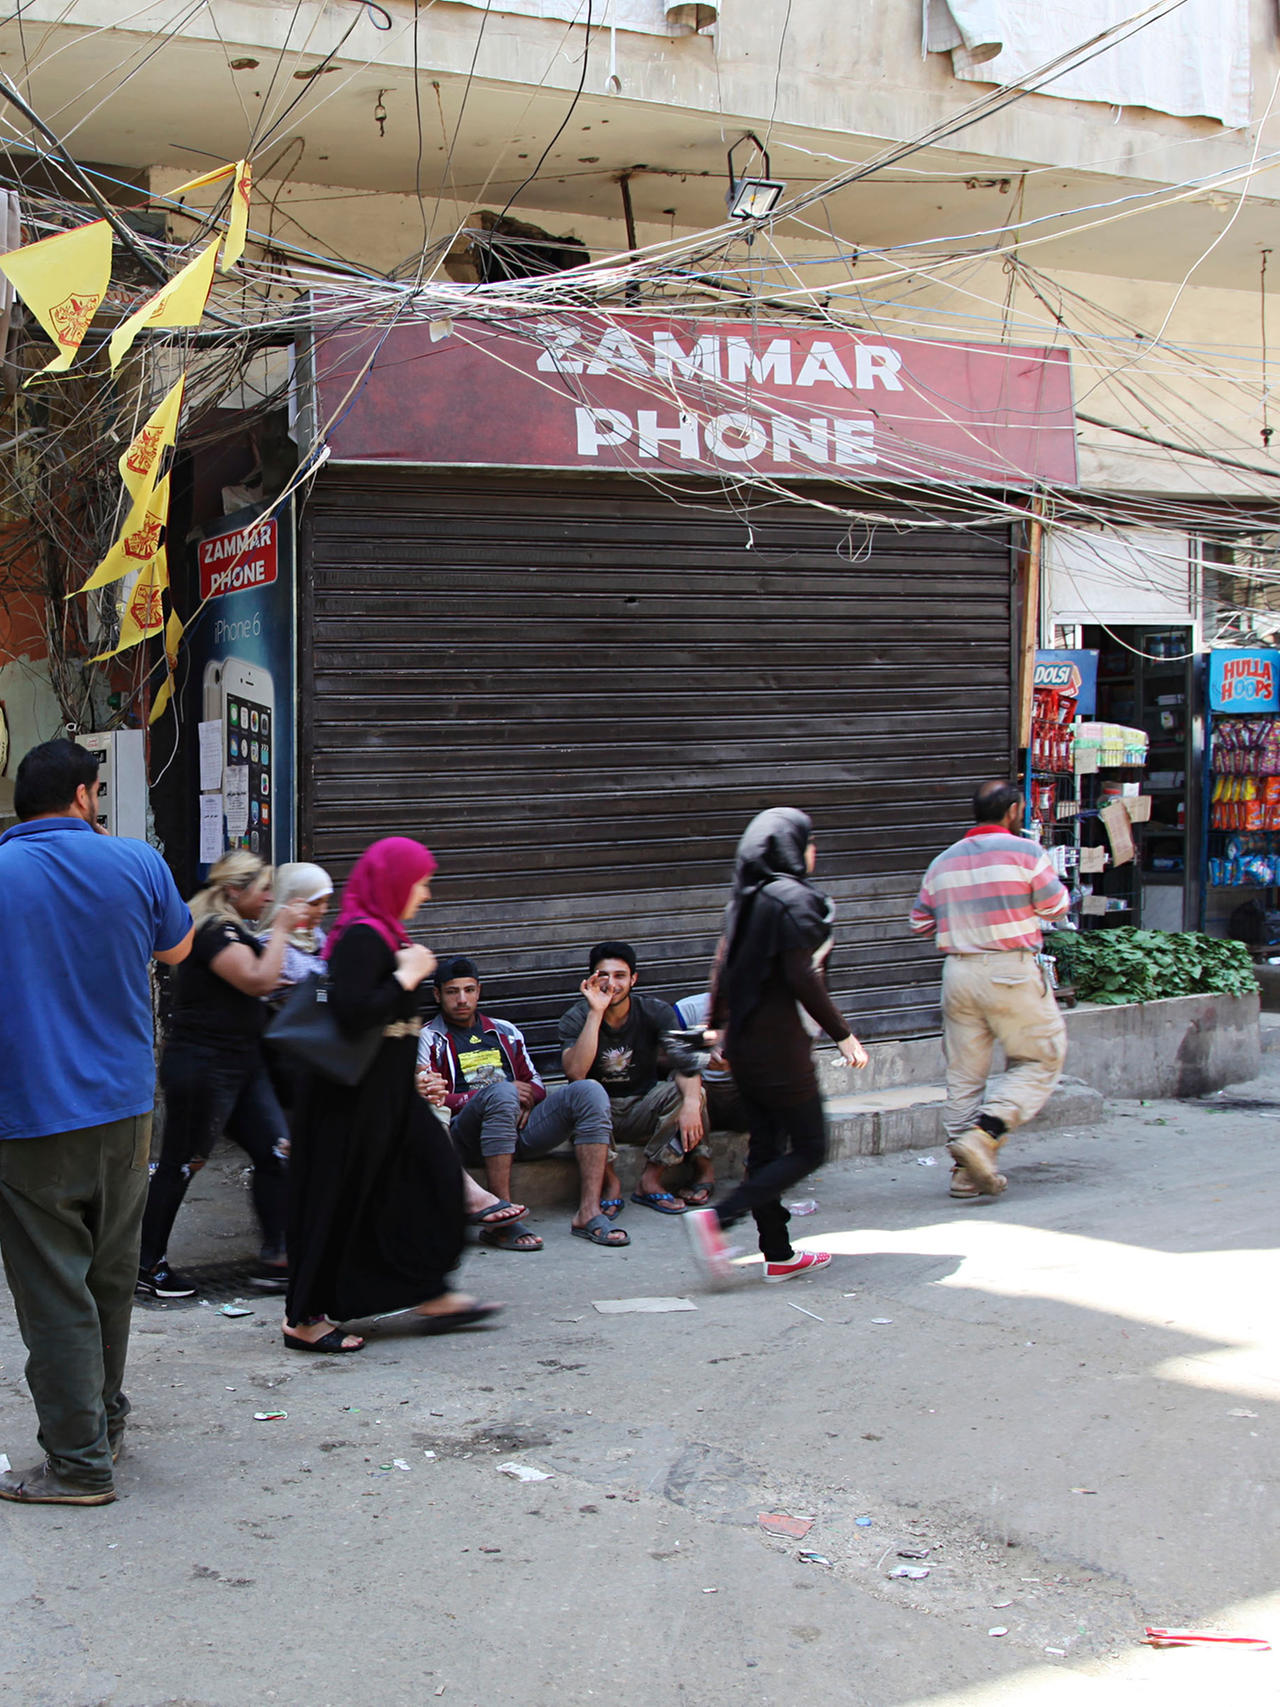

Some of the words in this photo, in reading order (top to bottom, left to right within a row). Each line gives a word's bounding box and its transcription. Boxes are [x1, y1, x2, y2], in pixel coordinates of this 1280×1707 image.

[536, 322, 904, 393] ZAMMAR
[575, 407, 878, 466] PHONE
[204, 525, 271, 564] ZAMMAR
[210, 560, 265, 593] PHONE
[1224, 658, 1272, 681] HULLA
[1221, 679, 1273, 701] HOOPS
